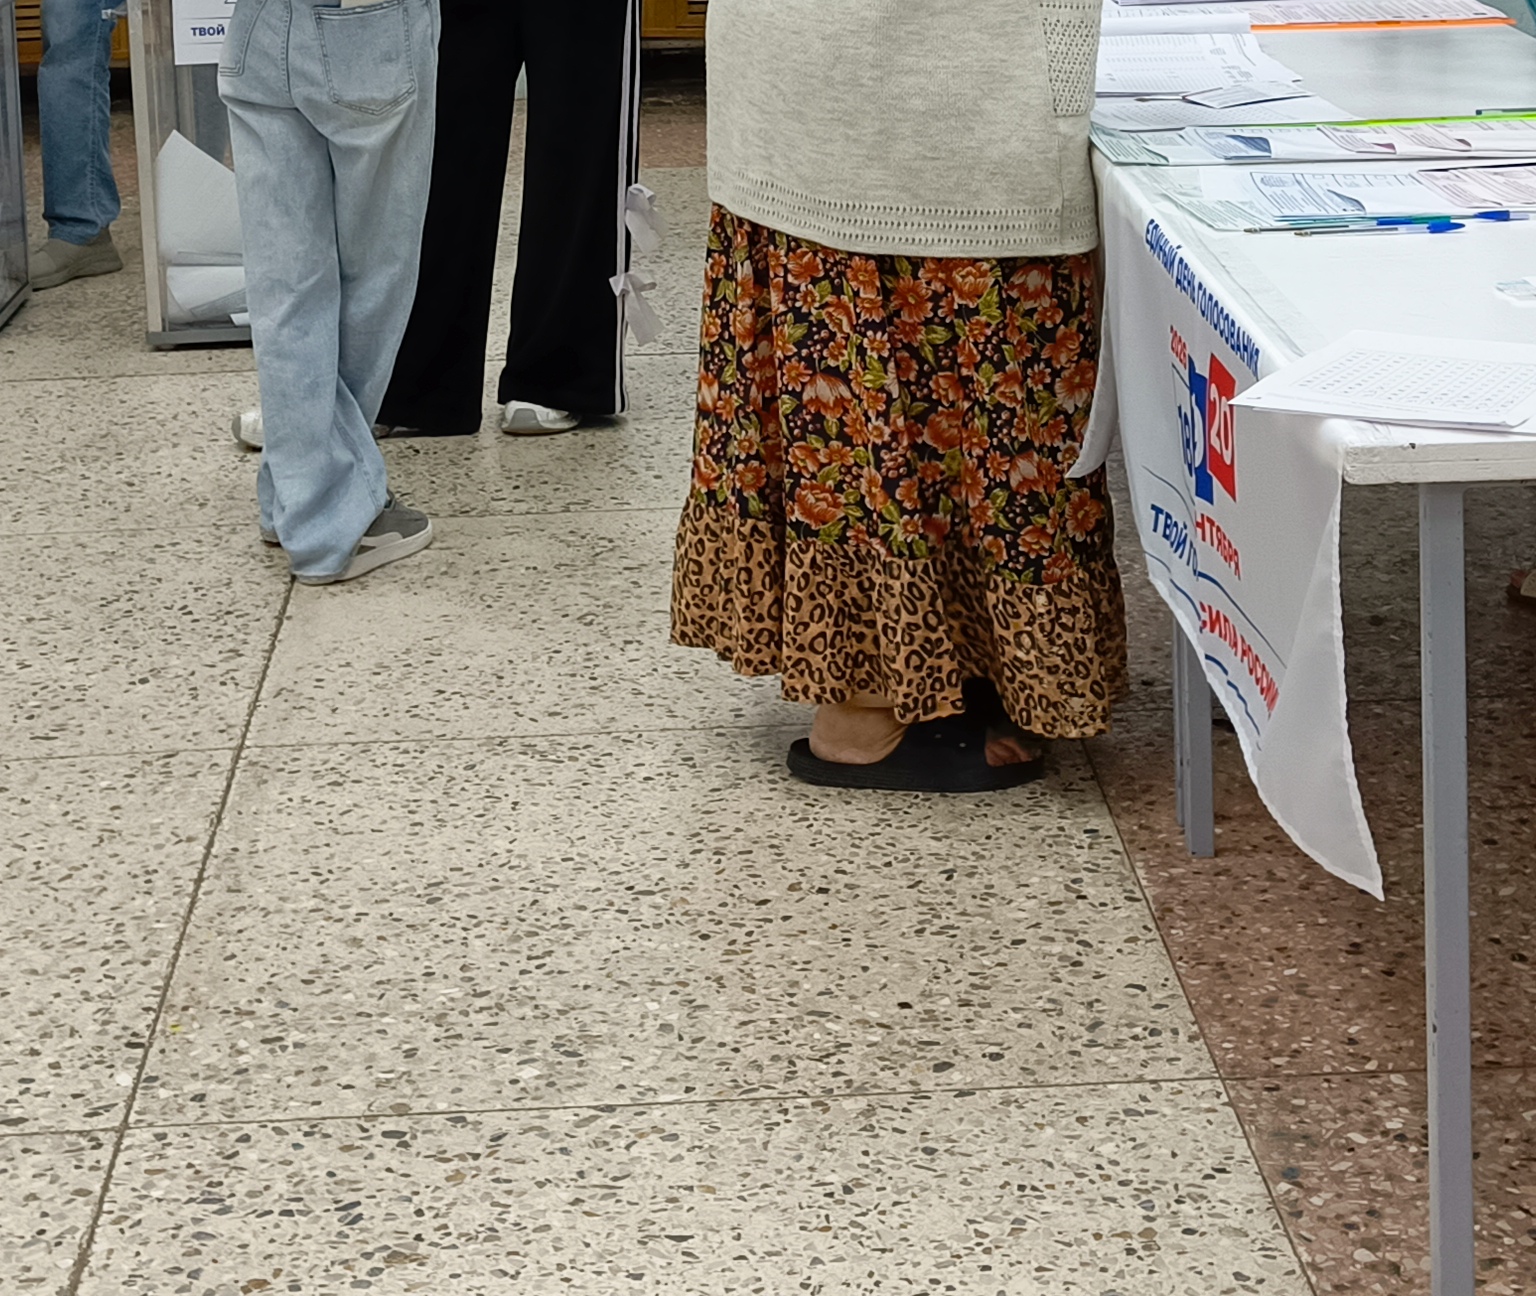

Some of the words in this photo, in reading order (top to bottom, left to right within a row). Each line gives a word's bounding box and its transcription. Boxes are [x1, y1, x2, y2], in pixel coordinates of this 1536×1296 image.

[190, 24, 225, 37] ТВОЙ
[1145, 219, 1183, 280] ЕДИНЫЙ
[1175, 256, 1196, 305] ДЕНЬ
[1196, 281, 1260, 382] ГОЛОСОВАНИЯ
[1177, 404, 1193, 478] 18
[1210, 383, 1233, 466] 20
[1150, 503, 1189, 560] ТВОЙ
